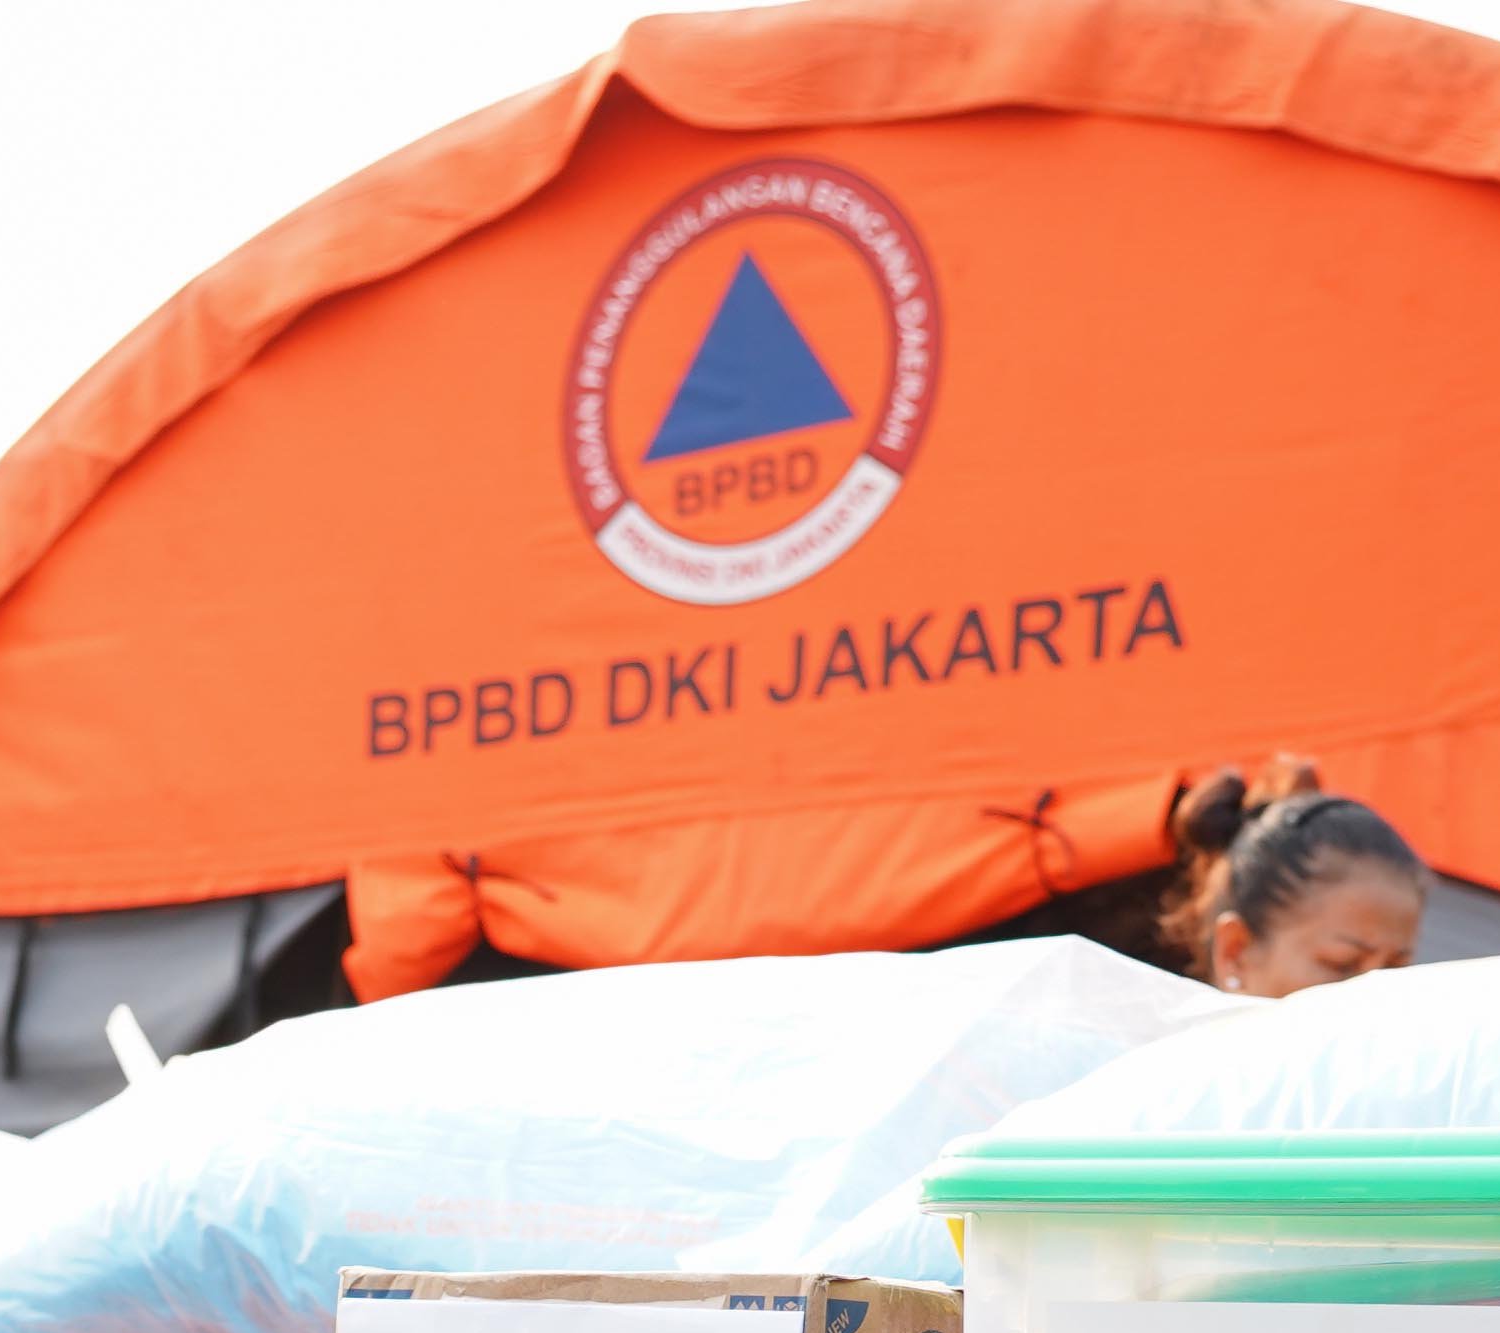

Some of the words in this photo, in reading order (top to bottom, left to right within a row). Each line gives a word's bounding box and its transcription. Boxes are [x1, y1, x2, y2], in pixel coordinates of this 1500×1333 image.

[676, 450, 817, 517] BPBD
[367, 673, 574, 758] BPBD
[607, 645, 736, 730] DKI
[768, 578, 1185, 703] JAKARTA
